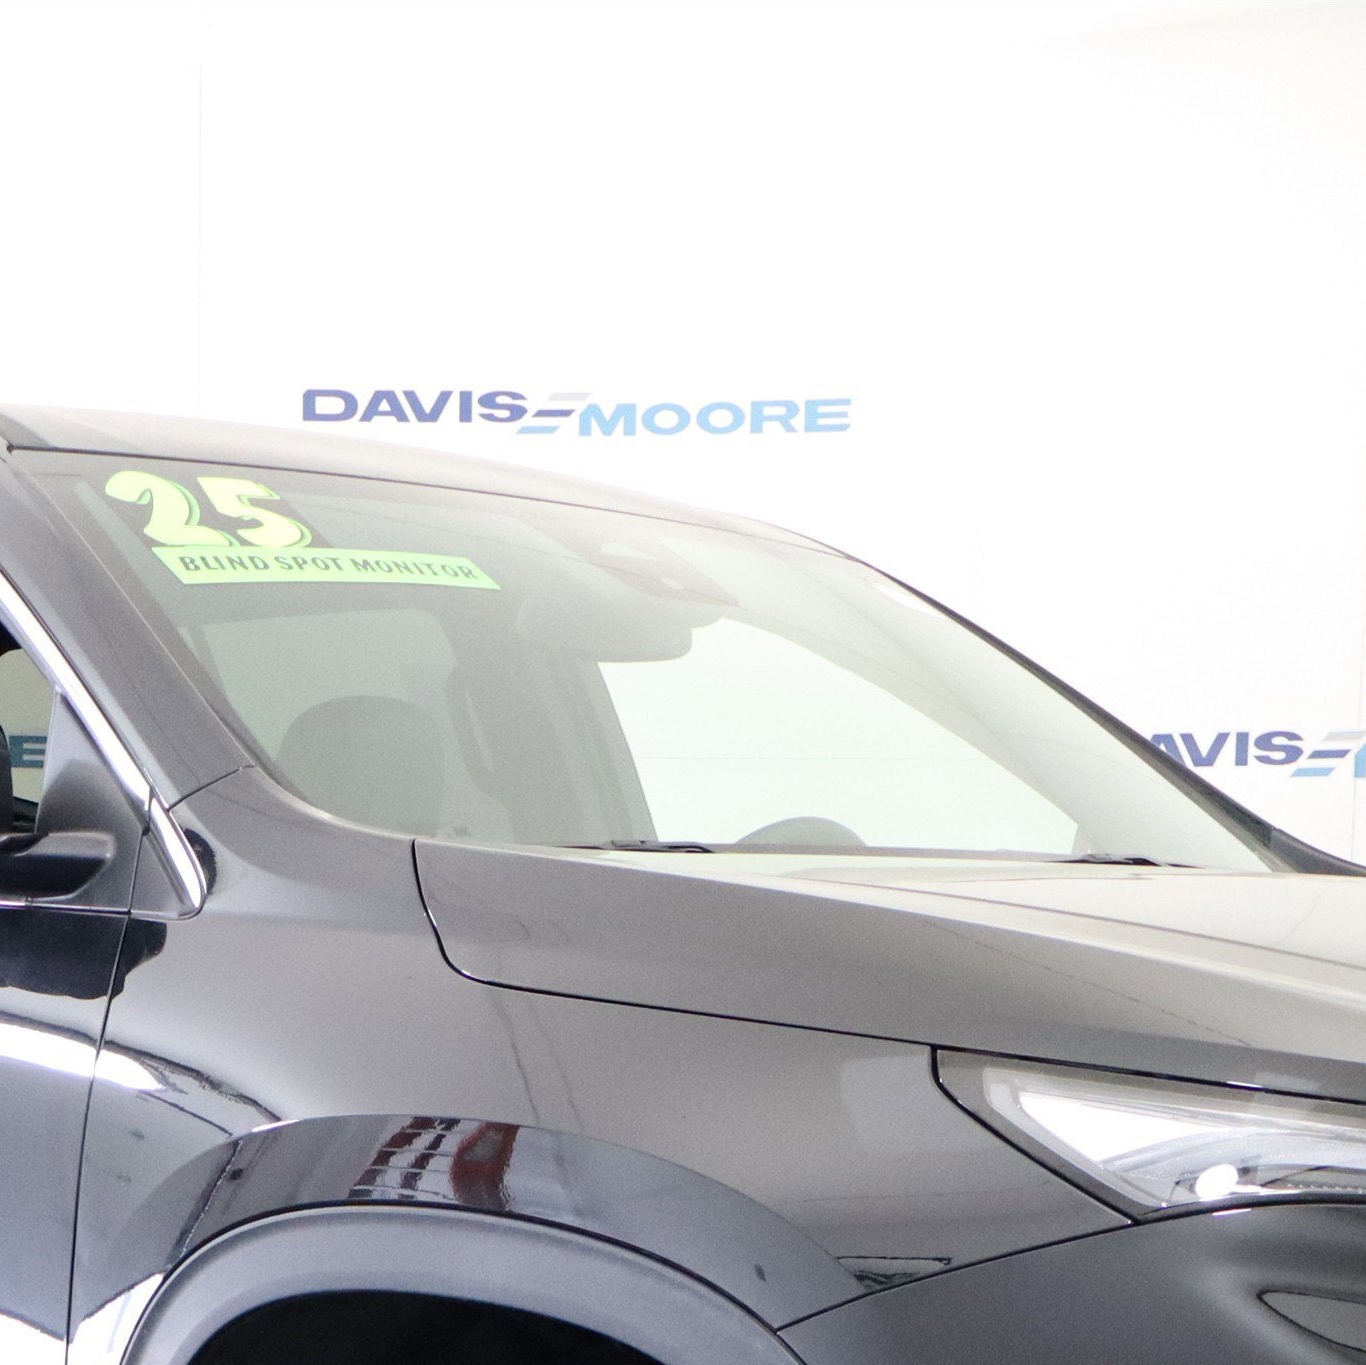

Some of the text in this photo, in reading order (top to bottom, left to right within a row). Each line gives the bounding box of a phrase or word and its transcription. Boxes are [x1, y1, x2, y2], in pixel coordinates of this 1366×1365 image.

[302, 389, 853, 438] DAVIS MOORE
[104, 469, 313, 549] 25
[178, 554, 480, 581] BLIND SPOT MONITOR
